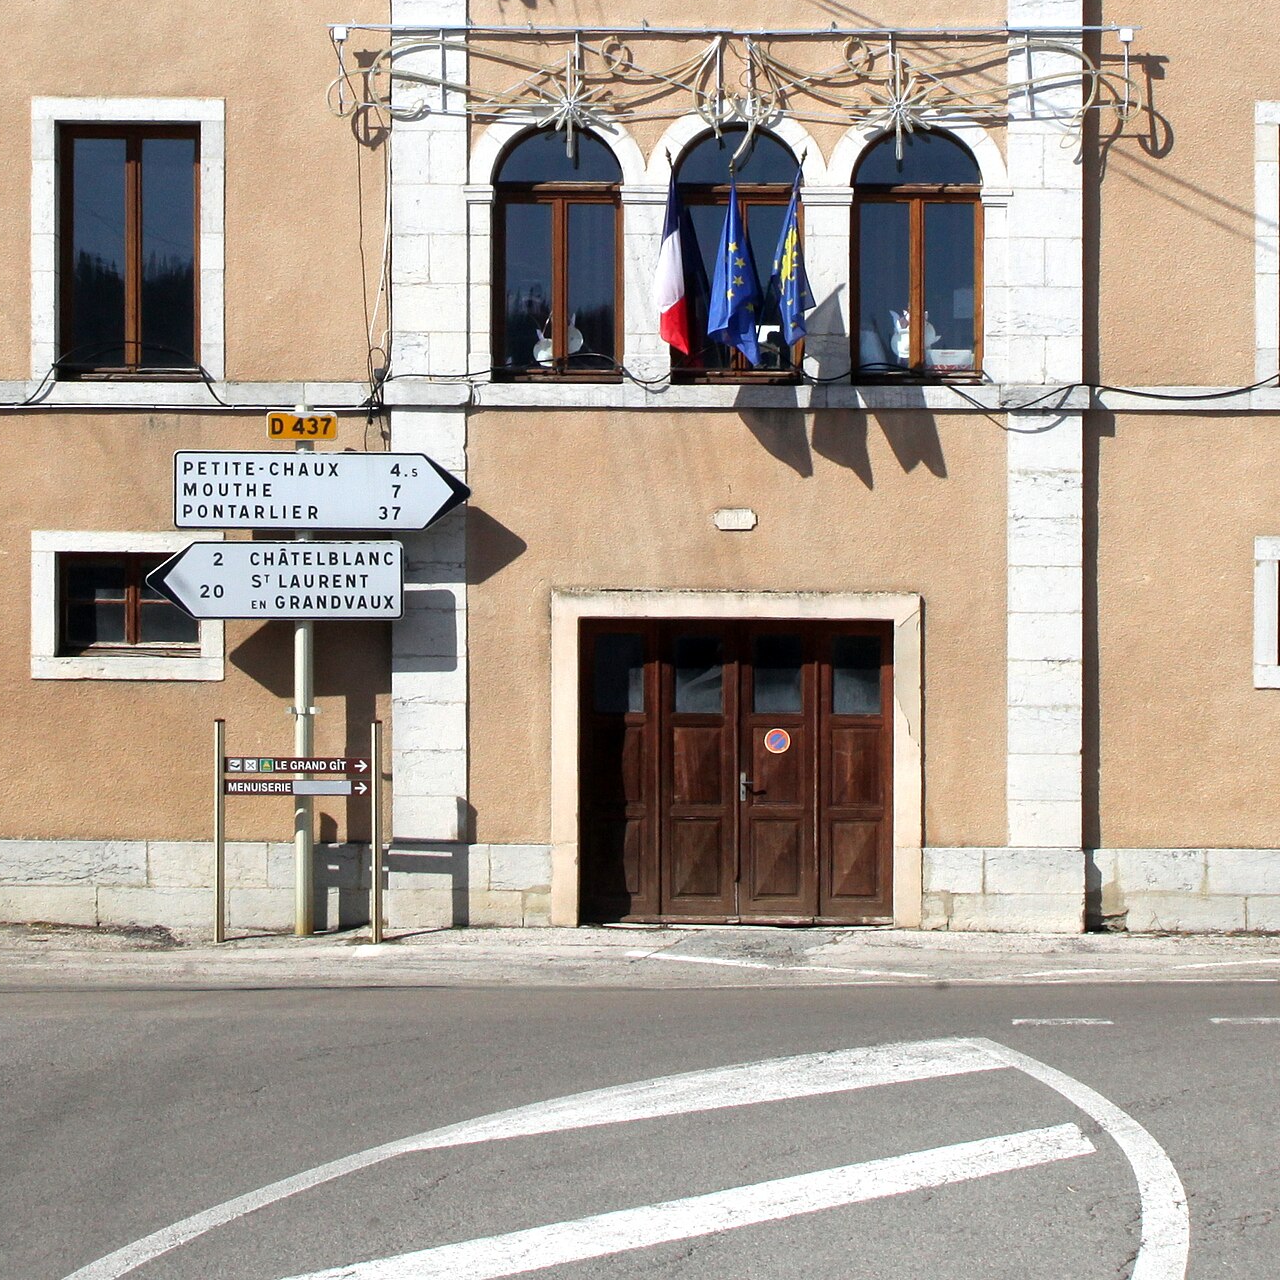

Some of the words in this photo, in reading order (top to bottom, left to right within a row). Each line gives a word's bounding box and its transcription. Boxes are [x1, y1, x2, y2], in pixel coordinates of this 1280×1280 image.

[271, 418, 284, 435] D
[292, 417, 332, 435] 437
[183, 461, 339, 477] PETITE-CHAUX
[390, 463, 418, 478] 4.5
[183, 482, 272, 498] MOUTHE
[391, 484, 402, 499] 7
[183, 504, 319, 520] PONTARLIER
[378, 506, 402, 520] 37
[213, 552, 224, 566] 2
[250, 548, 394, 566] CHÂTELBLANC
[278, 574, 369, 589] LAURENT
[200, 584, 224, 599] 20
[251, 600, 267, 610] EN
[275, 595, 394, 610] GRANDVAUX
[275, 760, 287, 771] LE
[290, 760, 327, 771] GRAND
[228, 782, 291, 793] MENUISERIE
